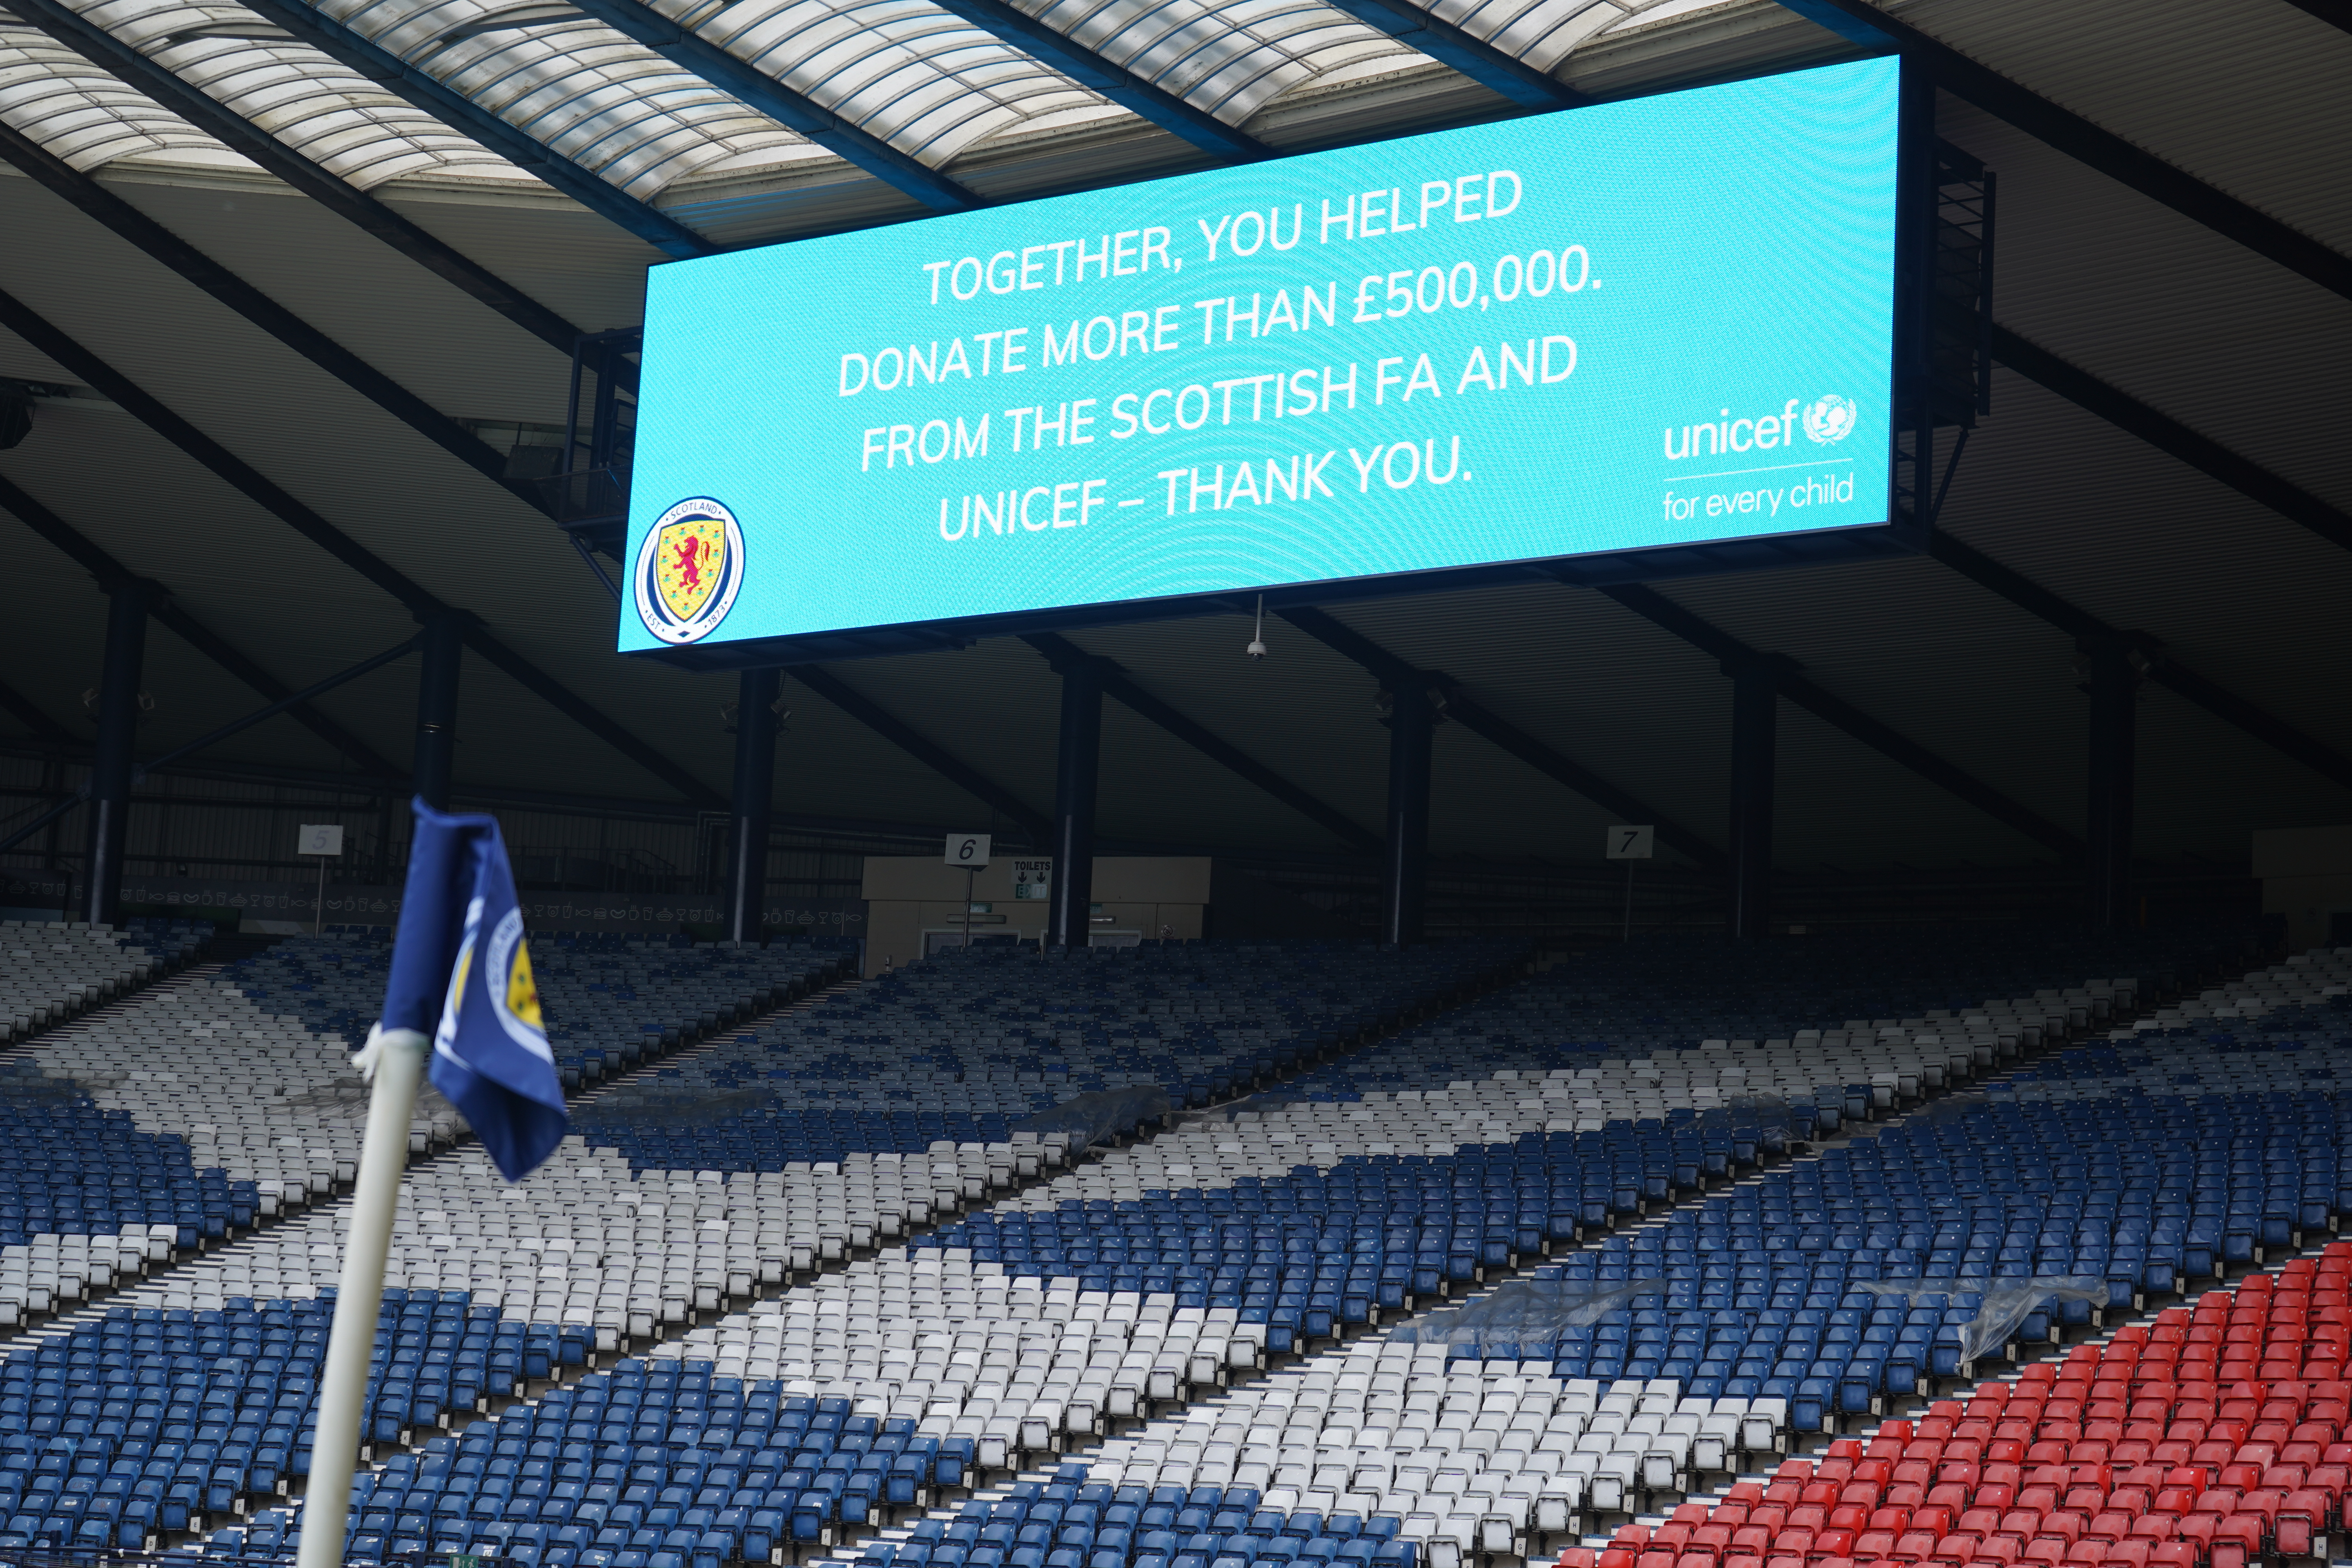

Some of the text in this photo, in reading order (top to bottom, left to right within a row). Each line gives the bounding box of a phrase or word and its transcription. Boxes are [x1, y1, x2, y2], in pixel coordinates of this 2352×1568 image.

[924, 170, 1522, 305] TOGETHER, YOU HELPED
[839, 245, 1601, 397] DONATE MORE THAN £500,000.
[862, 335, 1577, 472] FROM THE SCOTTISH FA AND
[1665, 399, 1798, 460] unicef
[940, 479, 1106, 541] UNICEF
[1158, 450, 1335, 515] THANK
[1349, 436, 1471, 493] YOU.
[1664, 472, 1853, 521] for every child
[671, 502, 718, 519] SCOTLAND
[646, 614, 661, 630] EST
[708, 605, 725, 625] 1873
[312, 830, 330, 849] 5
[958, 839, 976, 860] 6
[1621, 831, 1639, 853] 7
[1014, 861, 1051, 871] TOILETS
[1018, 886, 1045, 897] EXIT
